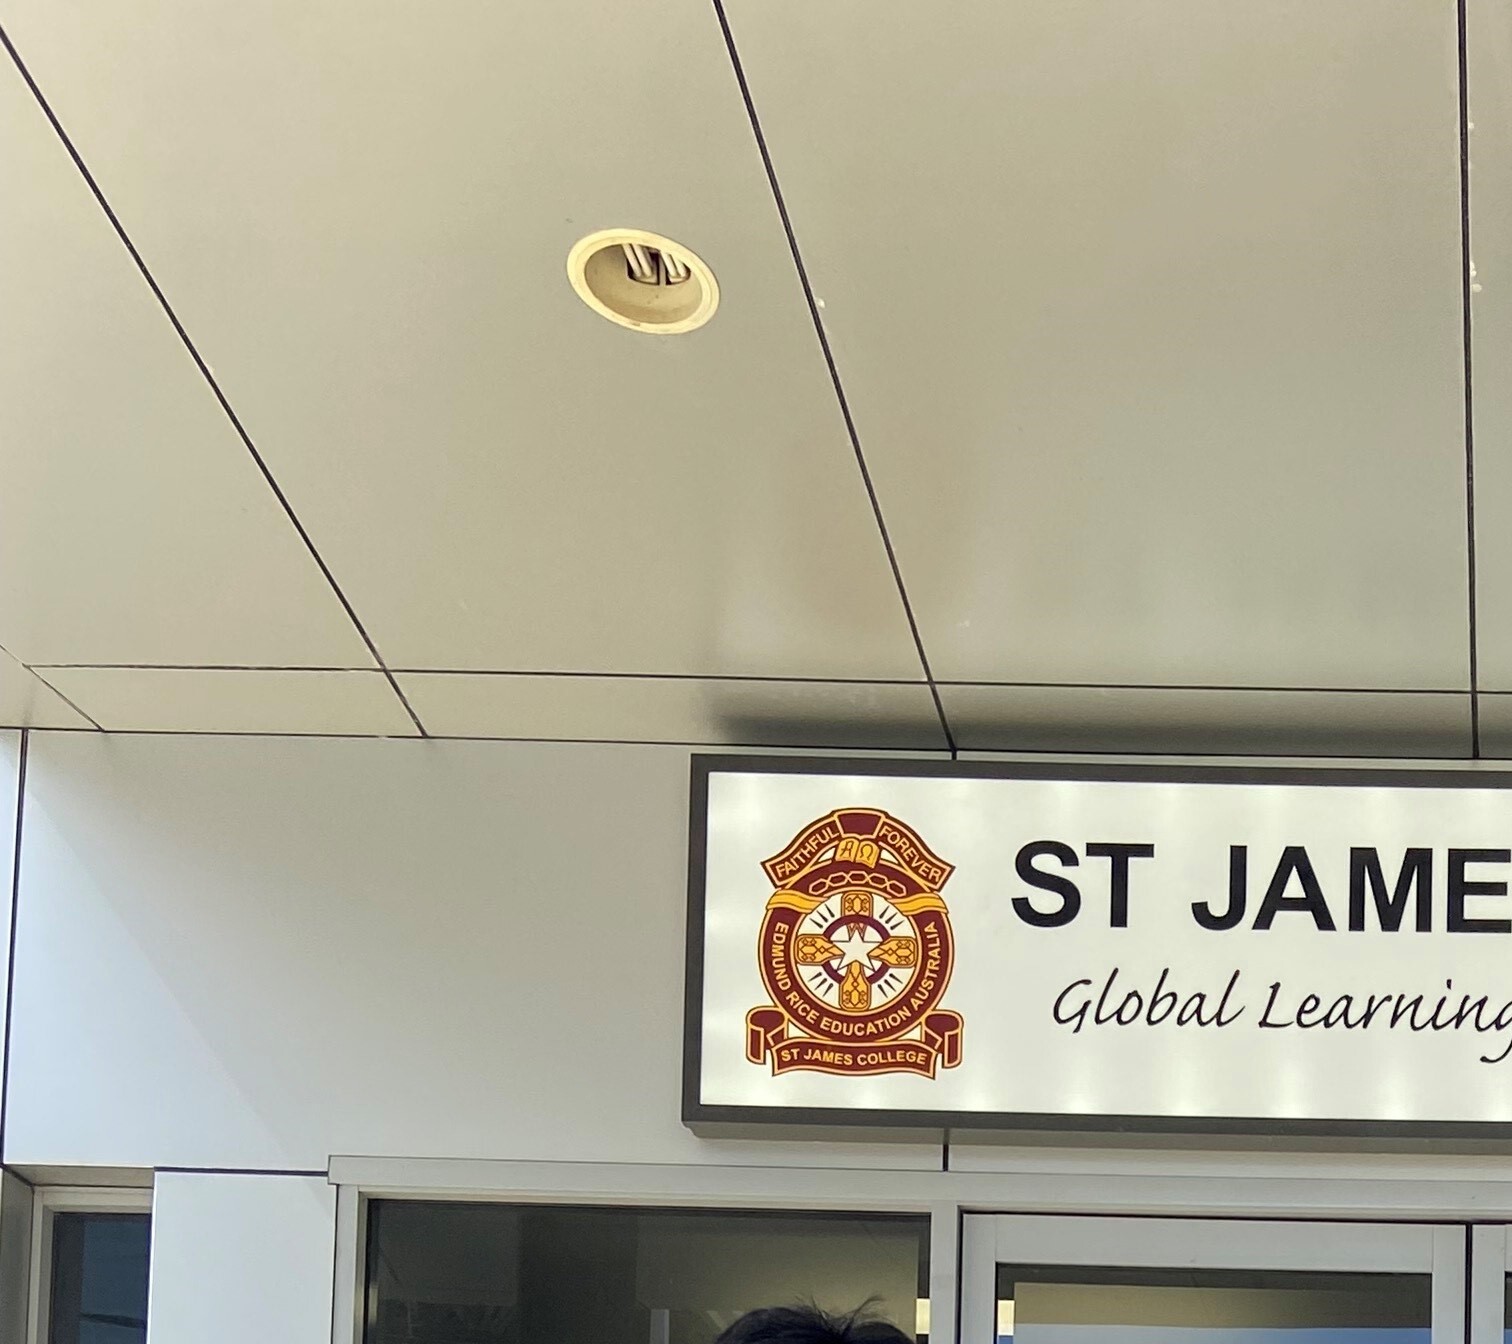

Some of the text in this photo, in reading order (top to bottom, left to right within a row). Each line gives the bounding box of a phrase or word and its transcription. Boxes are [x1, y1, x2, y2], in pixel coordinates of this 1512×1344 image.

[775, 825, 942, 882] FAITHFUL FOREVER
[1012, 841, 1154, 927] ST
[771, 921, 942, 1037] EDMUND RICE EDUCATION AUSTRALIA
[1054, 968, 1245, 1033] Global
[781, 1048, 927, 1066] ST JAMES COLLEGE
